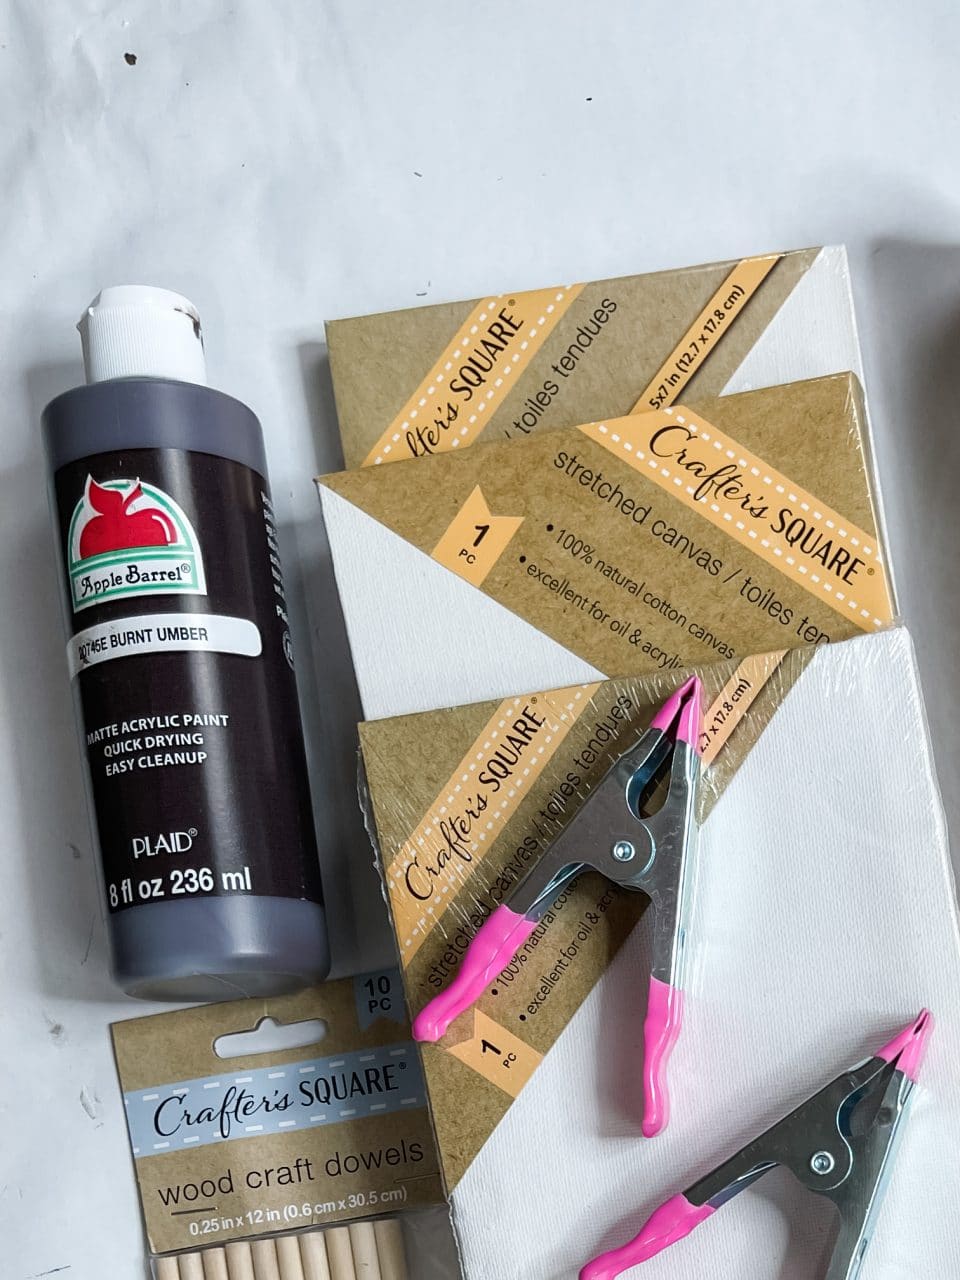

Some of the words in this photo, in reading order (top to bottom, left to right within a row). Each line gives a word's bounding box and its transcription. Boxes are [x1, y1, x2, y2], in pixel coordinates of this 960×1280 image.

[449, 307, 524, 402] SQUARE
[513, 380, 559, 434] toiles
[552, 298, 617, 378] tendues
[649, 385, 669, 410] 5x7
[664, 373, 680, 387] in
[675, 342, 700, 373] (12.7
[703, 309, 725, 334] 17.8
[723, 284, 745, 310] cm)
[649, 425, 768, 520] Crafter's
[770, 508, 866, 586] SQUARE
[458, 548, 477, 565] PC
[473, 524, 490, 547] 1
[553, 451, 652, 526] stretched
[652, 519, 723, 576] canvas
[739, 576, 794, 626] toiles
[81, 575, 123, 598] Apple
[125, 564, 182, 583] Barrel
[527, 563, 588, 611] excellent
[588, 603, 611, 624] for
[609, 618, 632, 638] oil
[554, 529, 593, 565] 100%
[594, 559, 646, 597] natural
[643, 593, 687, 628] cotton
[688, 622, 735, 660] canvas
[110, 628, 152, 648] BURNT
[157, 626, 209, 642] UMBER
[713, 701, 734, 725] 17.8
[731, 678, 752, 703] cm)
[87, 723, 119, 746] MATTE
[121, 714, 180, 732] ACRYLIC
[183, 714, 229, 727] PAINT
[103, 738, 143, 758] QUICK
[145, 733, 204, 749] DRYING
[105, 758, 135, 777] EASY
[138, 751, 208, 769] CLEANUP
[405, 792, 488, 901] Crafter's
[479, 705, 546, 792] SQUARE
[488, 835, 539, 902] canvas
[539, 772, 581, 822] toiles
[574, 695, 632, 771] tendues
[132, 831, 193, 859] PLAID
[109, 883, 119, 907] 8
[120, 879, 133, 903] fl
[138, 878, 165, 899] oz
[169, 867, 214, 894] 236
[221, 866, 252, 891] ml
[523, 911, 556, 956] natural
[364, 976, 391, 997] 10
[527, 959, 569, 1015] excellent
[560, 941, 583, 964] for
[578, 921, 593, 942] oil
[368, 998, 392, 1014] PC
[481, 1039, 502, 1055] 1
[502, 1052, 518, 1069] PC
[153, 1086, 294, 1139] Crafter's
[298, 1064, 399, 1107] SQUARE
[158, 1168, 234, 1207] wood
[246, 1158, 315, 1190] craft
[325, 1139, 424, 1177] dowels
[189, 1217, 220, 1236] 0.25
[221, 1213, 235, 1230] in
[246, 1209, 264, 1225] 12
[266, 1205, 281, 1222] in
[283, 1202, 314, 1222] (0.6
[314, 1199, 336, 1214] cm
[348, 1192, 379, 1209] 30.5
[381, 1185, 408, 1205] cm)
